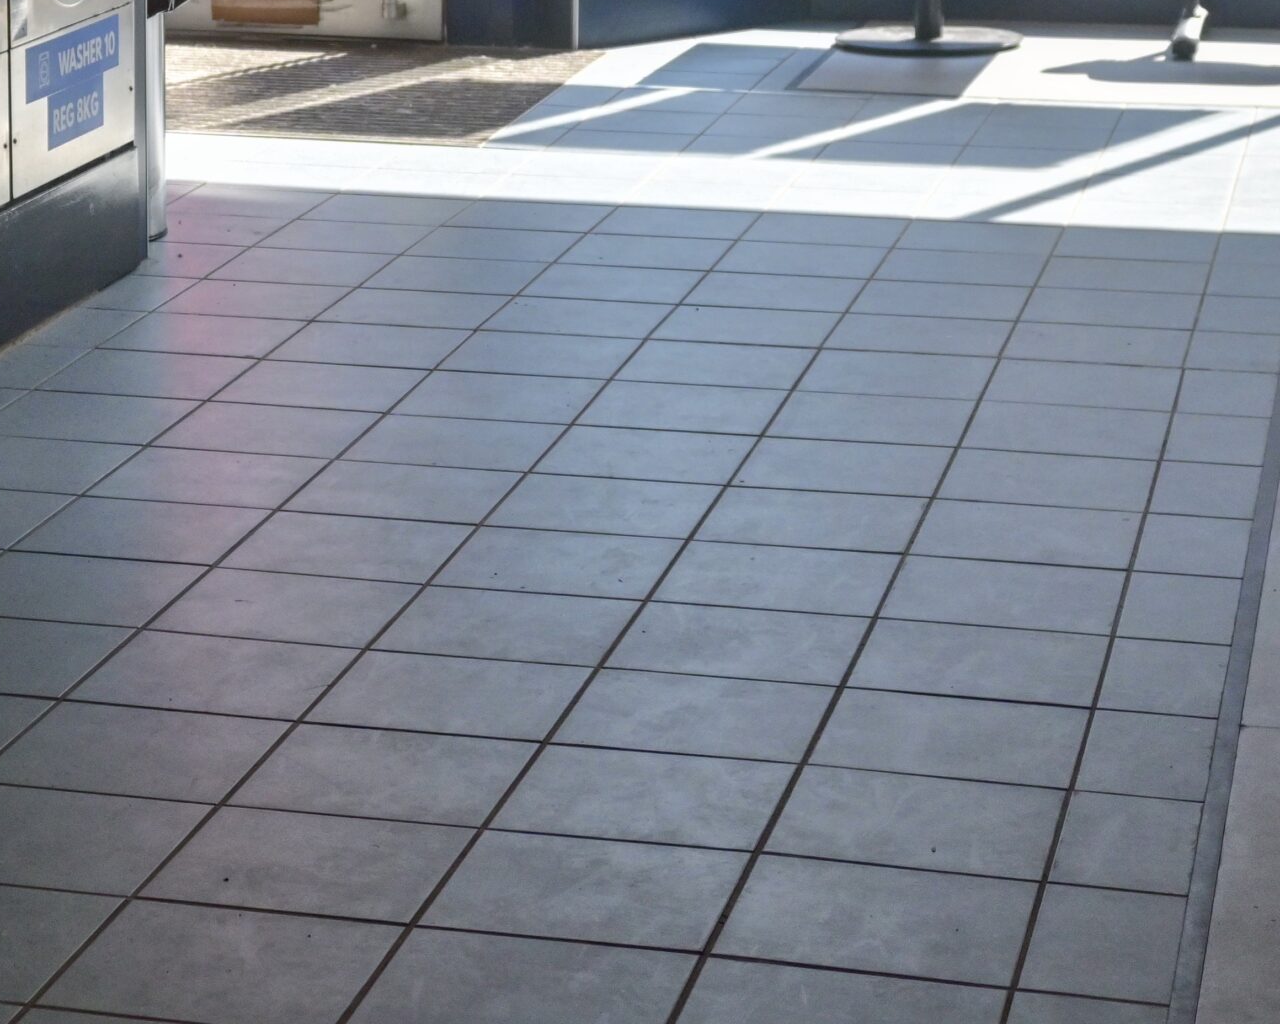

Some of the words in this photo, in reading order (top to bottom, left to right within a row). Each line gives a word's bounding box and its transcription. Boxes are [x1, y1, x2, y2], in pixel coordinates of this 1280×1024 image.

[58, 36, 103, 77] WASHER
[104, 31, 115, 57] 10
[53, 102, 75, 134] REG
[76, 91, 99, 123] 8KG
